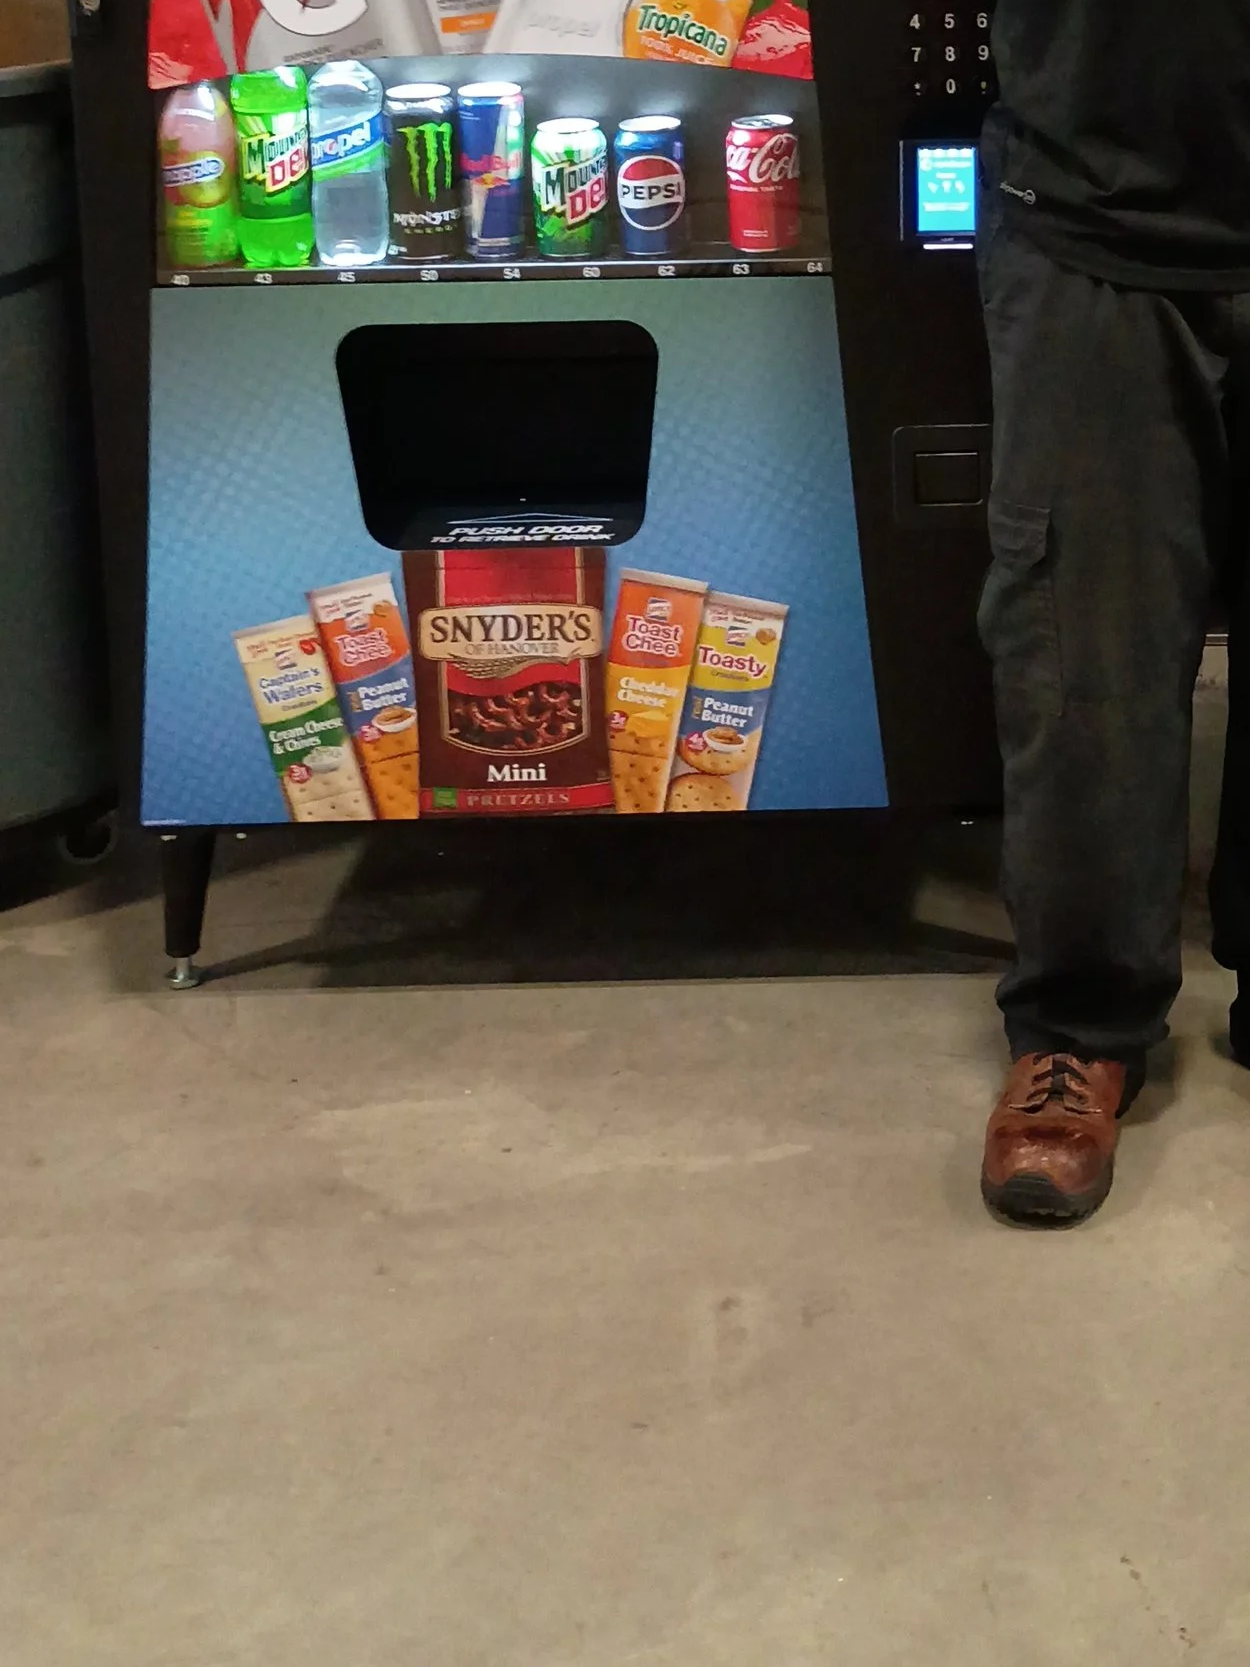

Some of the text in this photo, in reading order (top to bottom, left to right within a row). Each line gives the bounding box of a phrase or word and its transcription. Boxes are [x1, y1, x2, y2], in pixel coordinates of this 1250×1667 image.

[909, 12, 988, 29] 4 5 6
[638, 5, 728, 56] Tropicana
[911, 45, 989, 62] 7 8 9
[945, 78, 956, 94] 0
[622, 182, 682, 201] PEPSI
[420, 269, 439, 281] 50
[503, 268, 521, 280] 54
[582, 266, 601, 278] 60
[657, 265, 676, 277] 62
[732, 263, 750, 275] 63
[806, 262, 824, 273] 64
[337, 272, 355, 283] 45
[449, 524, 604, 536] PUSH DOOR
[458, 534, 547, 543] RETRIEVE
[552, 533, 616, 541] DRINK
[430, 610, 593, 644] SNYDER'S
[627, 616, 681, 642] Toast
[337, 628, 385, 652] Toast
[625, 632, 677, 656] Chee
[342, 644, 392, 667] Chee
[464, 642, 559, 656] OF HANOVER
[699, 646, 767, 677] Toasty
[263, 681, 324, 705] Wafers
[703, 696, 754, 719] Peanut
[701, 709, 748, 729] Butter
[487, 763, 547, 783] Mini
[466, 792, 571, 807] PRETZELS
